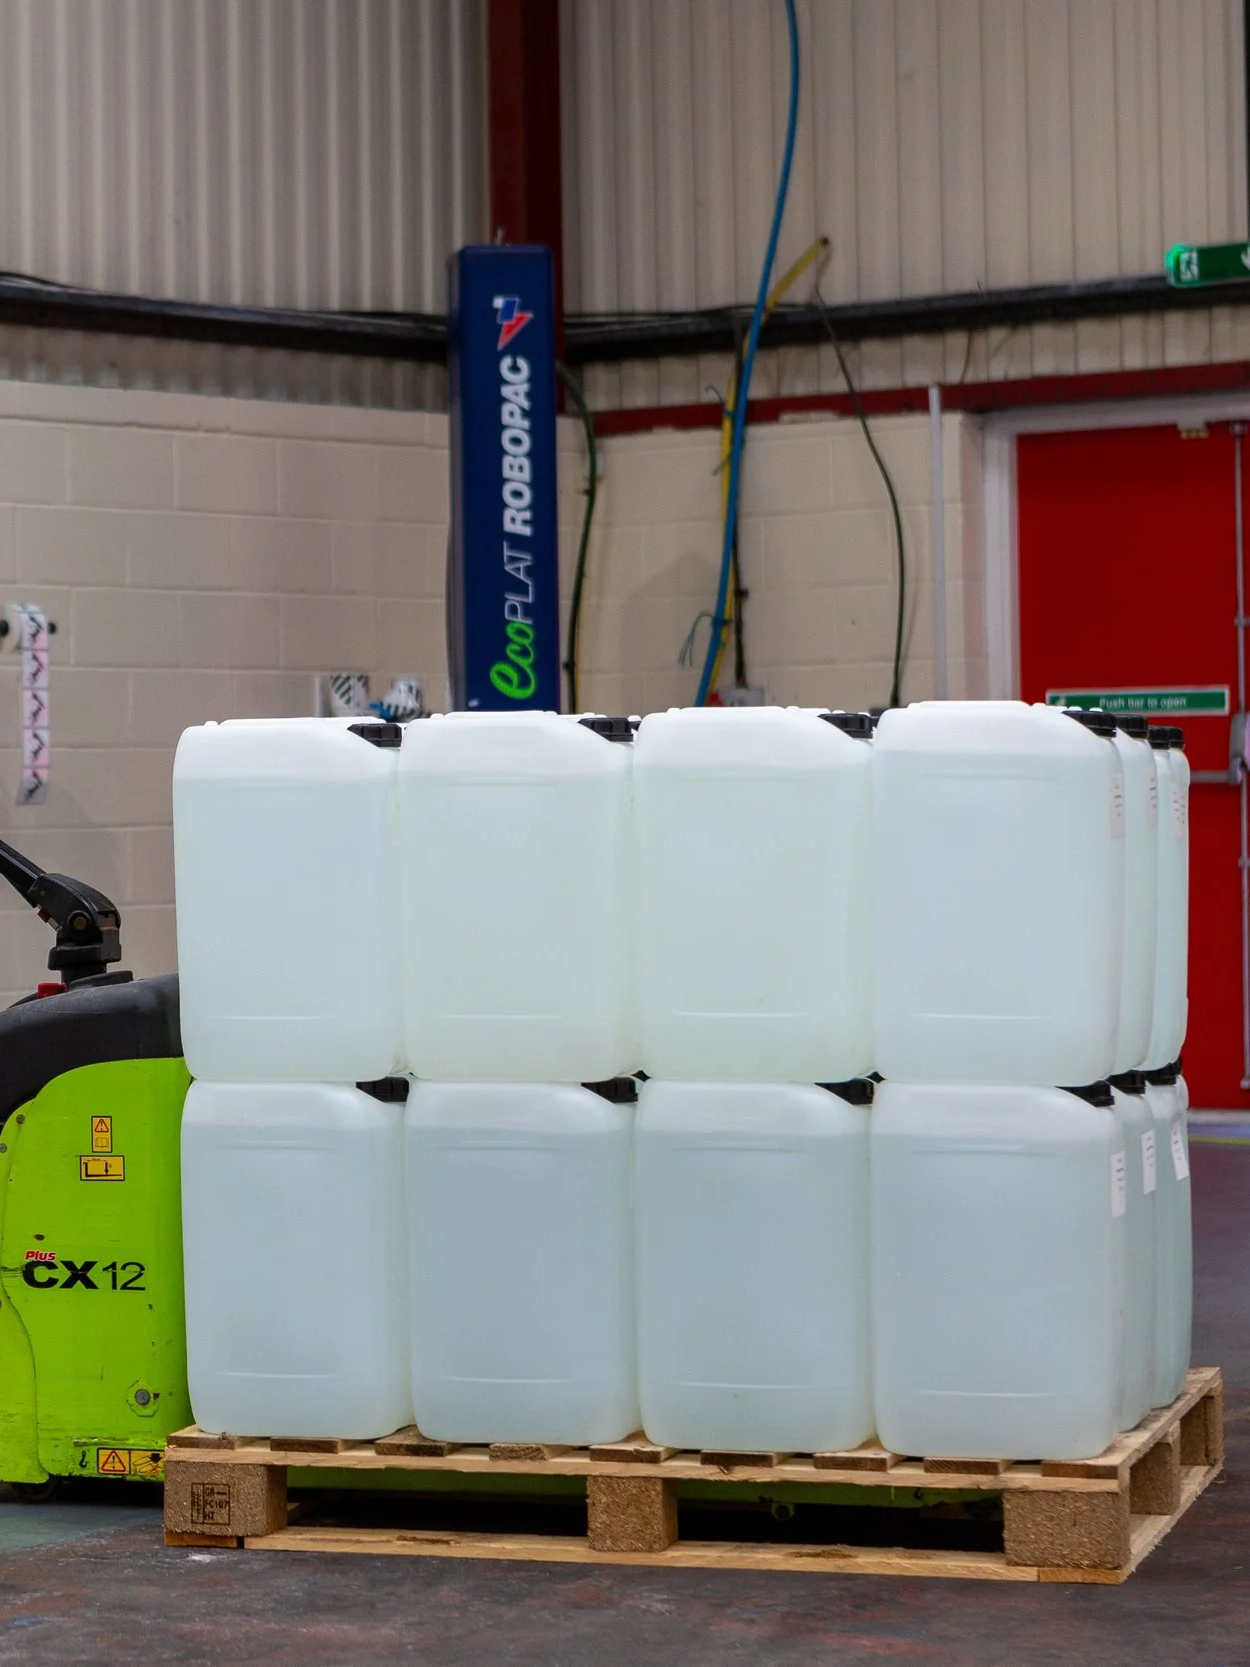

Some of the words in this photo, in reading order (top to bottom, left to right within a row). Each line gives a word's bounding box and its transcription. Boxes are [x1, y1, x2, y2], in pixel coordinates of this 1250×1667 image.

[499, 354, 533, 538] ROBOPAC
[490, 541, 535, 699] ecoPLAT
[1100, 697, 1125, 709] Push
[1127, 697, 1144, 708] bar
[1147, 697, 1157, 708] to
[1160, 696, 1187, 709] open
[25, 1250, 56, 1261] Plus
